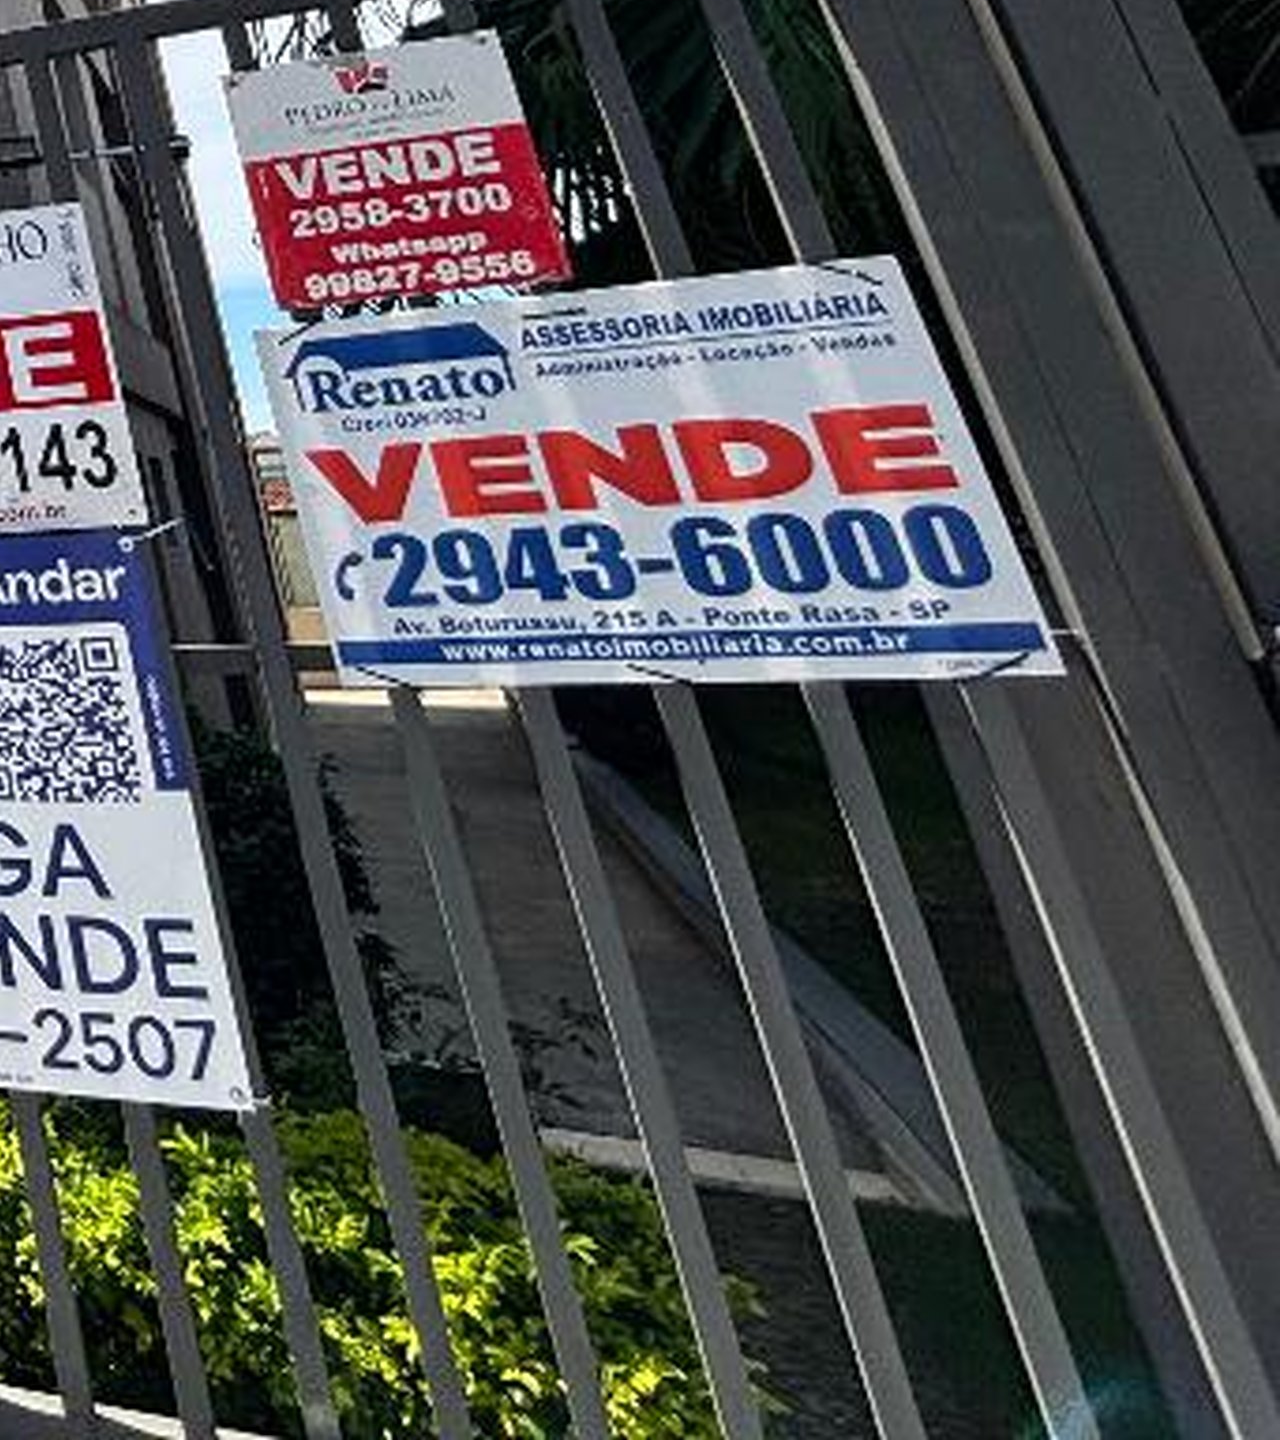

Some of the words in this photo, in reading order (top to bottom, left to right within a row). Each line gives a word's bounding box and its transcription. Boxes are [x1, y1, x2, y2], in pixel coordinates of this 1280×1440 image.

[276, 132, 500, 199] VENDE
[290, 184, 512, 239] 2958-3700
[331, 231, 488, 264] Whatsapp
[521, 310, 693, 349] ASSESSORIA
[306, 367, 504, 413] Renato
[304, 402, 961, 526] VENDE
[371, 503, 994, 609] 2943-6000
[394, 616, 431, 635] Av.
[594, 610, 647, 629] 215
[656, 610, 677, 626] A
[703, 606, 790, 626] Ponte
[800, 604, 880, 624] Rasa
[909, 598, 950, 620] SP
[441, 630, 909, 661] www.renatoimobiliaria.com.br
